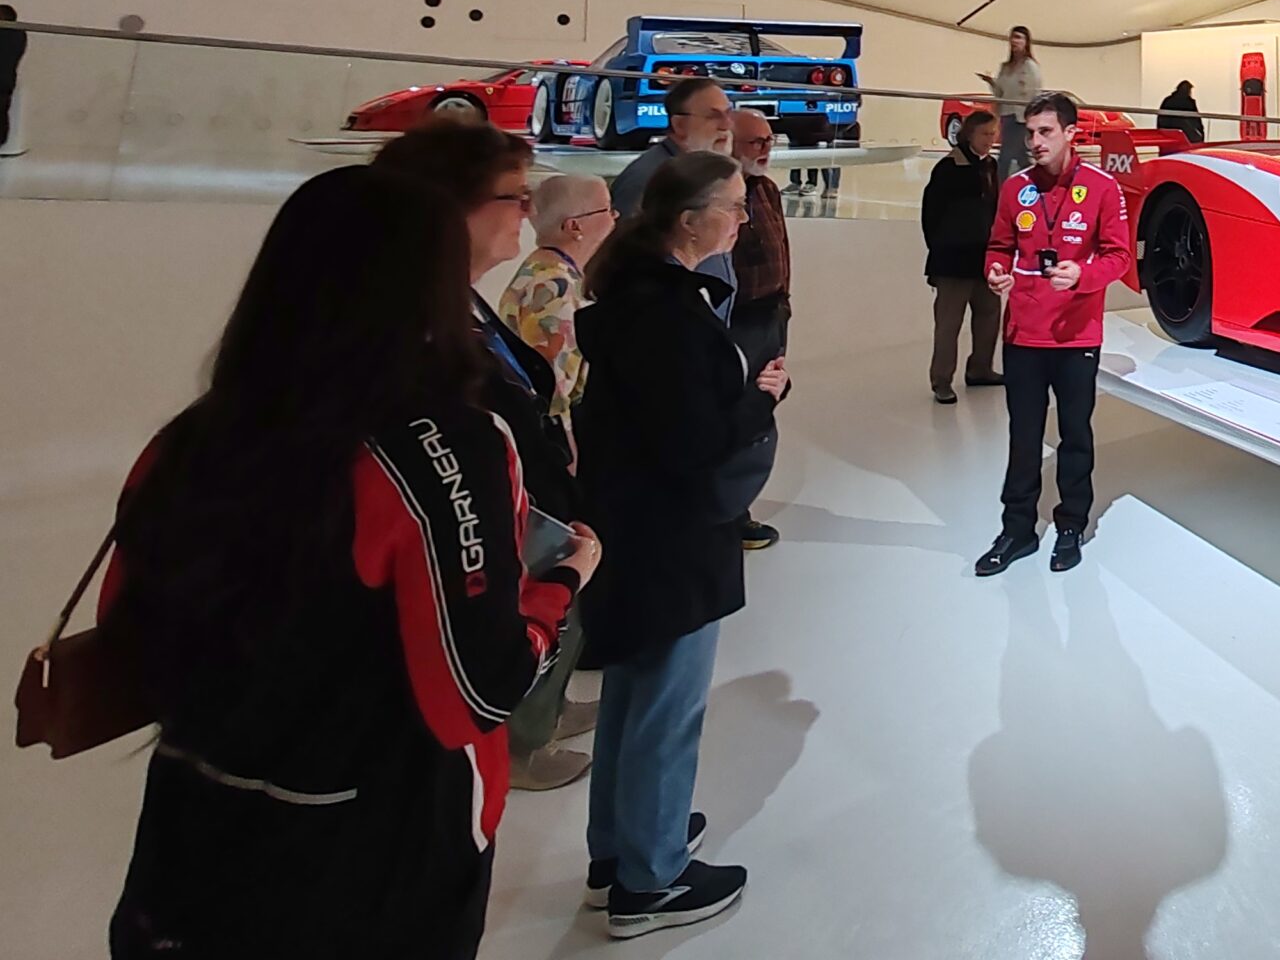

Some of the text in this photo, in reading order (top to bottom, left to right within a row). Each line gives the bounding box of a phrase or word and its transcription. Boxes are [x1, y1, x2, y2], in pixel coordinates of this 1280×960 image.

[825, 103, 858, 113] PILOT
[1105, 153, 1134, 174] FXX
[408, 417, 486, 574] GARNEAU
